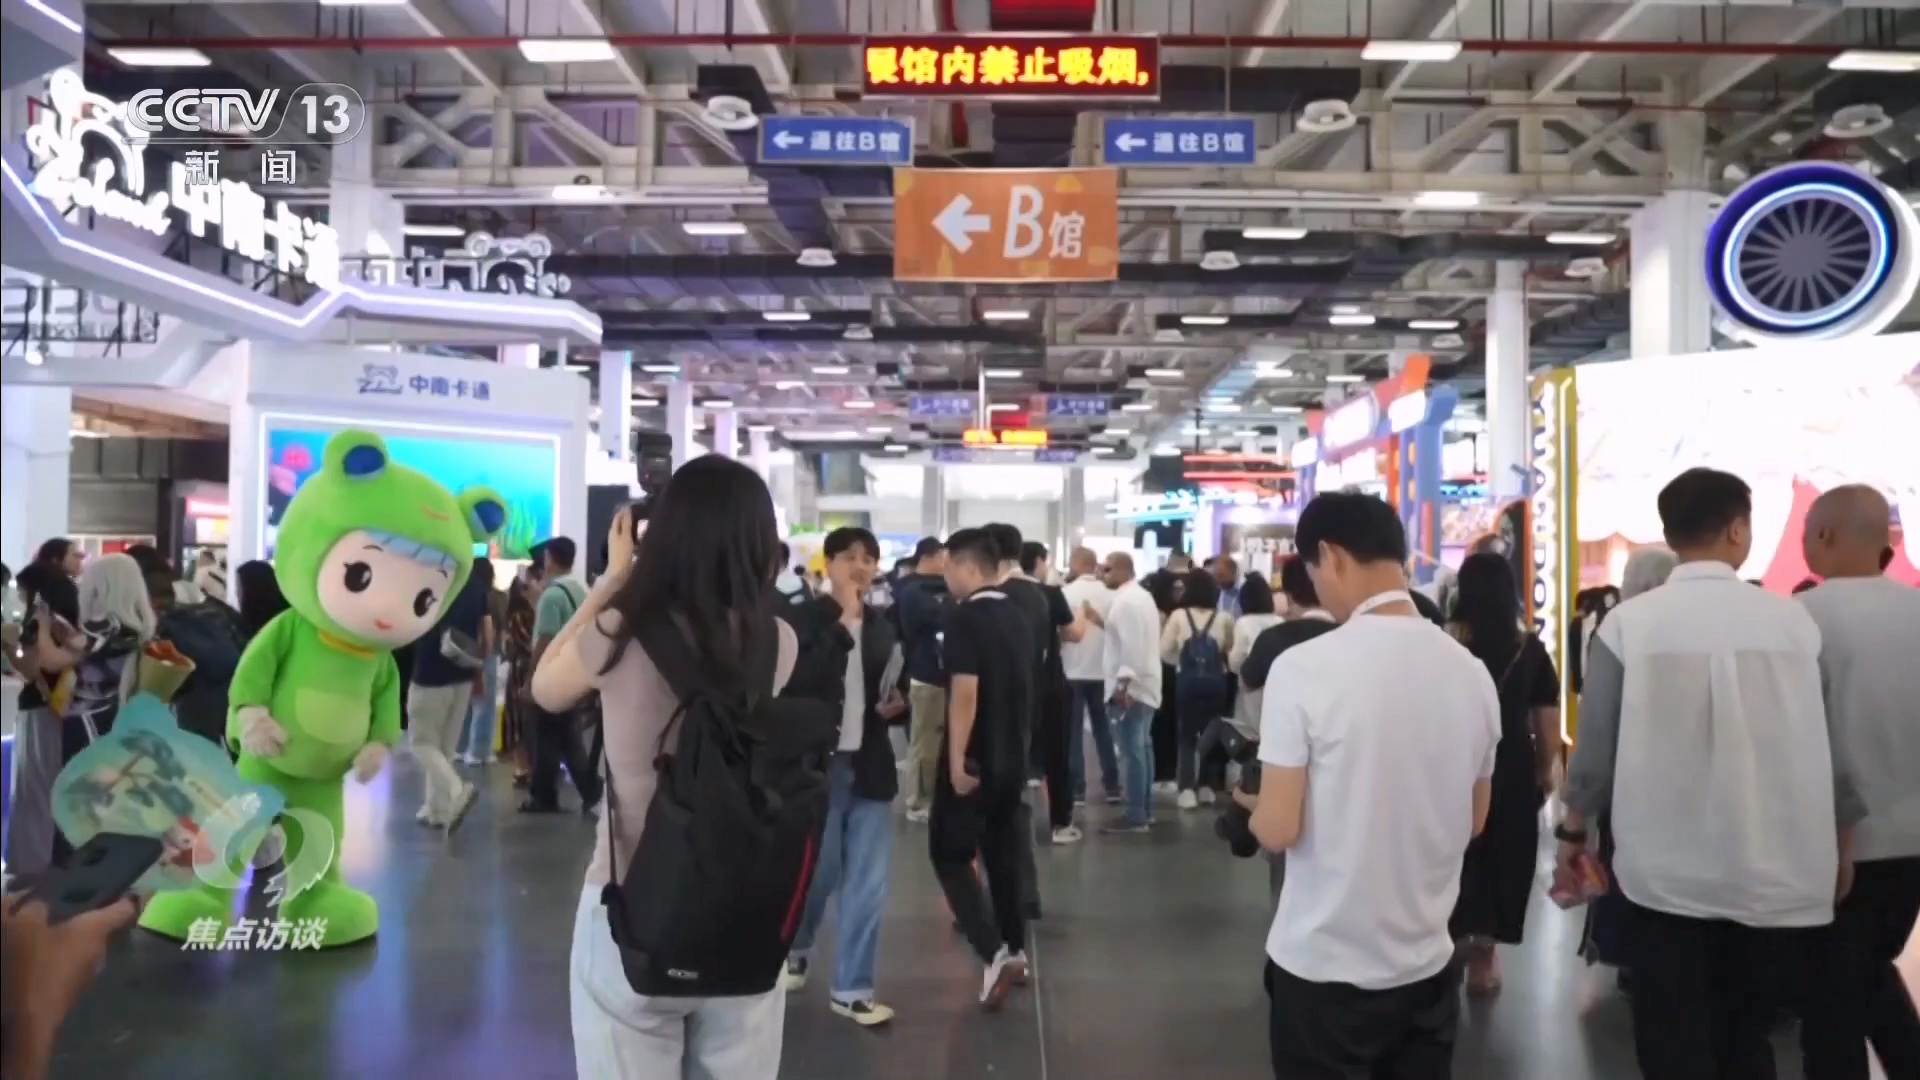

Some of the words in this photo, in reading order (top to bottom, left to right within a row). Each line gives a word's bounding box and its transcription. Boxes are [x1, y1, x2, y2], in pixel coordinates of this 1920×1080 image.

[811, 130, 901, 153] 通往B馆
[1153, 131, 1245, 153] 通往B馆
[1003, 185, 1085, 260] B馆
[409, 374, 490, 400] 中南卡通
